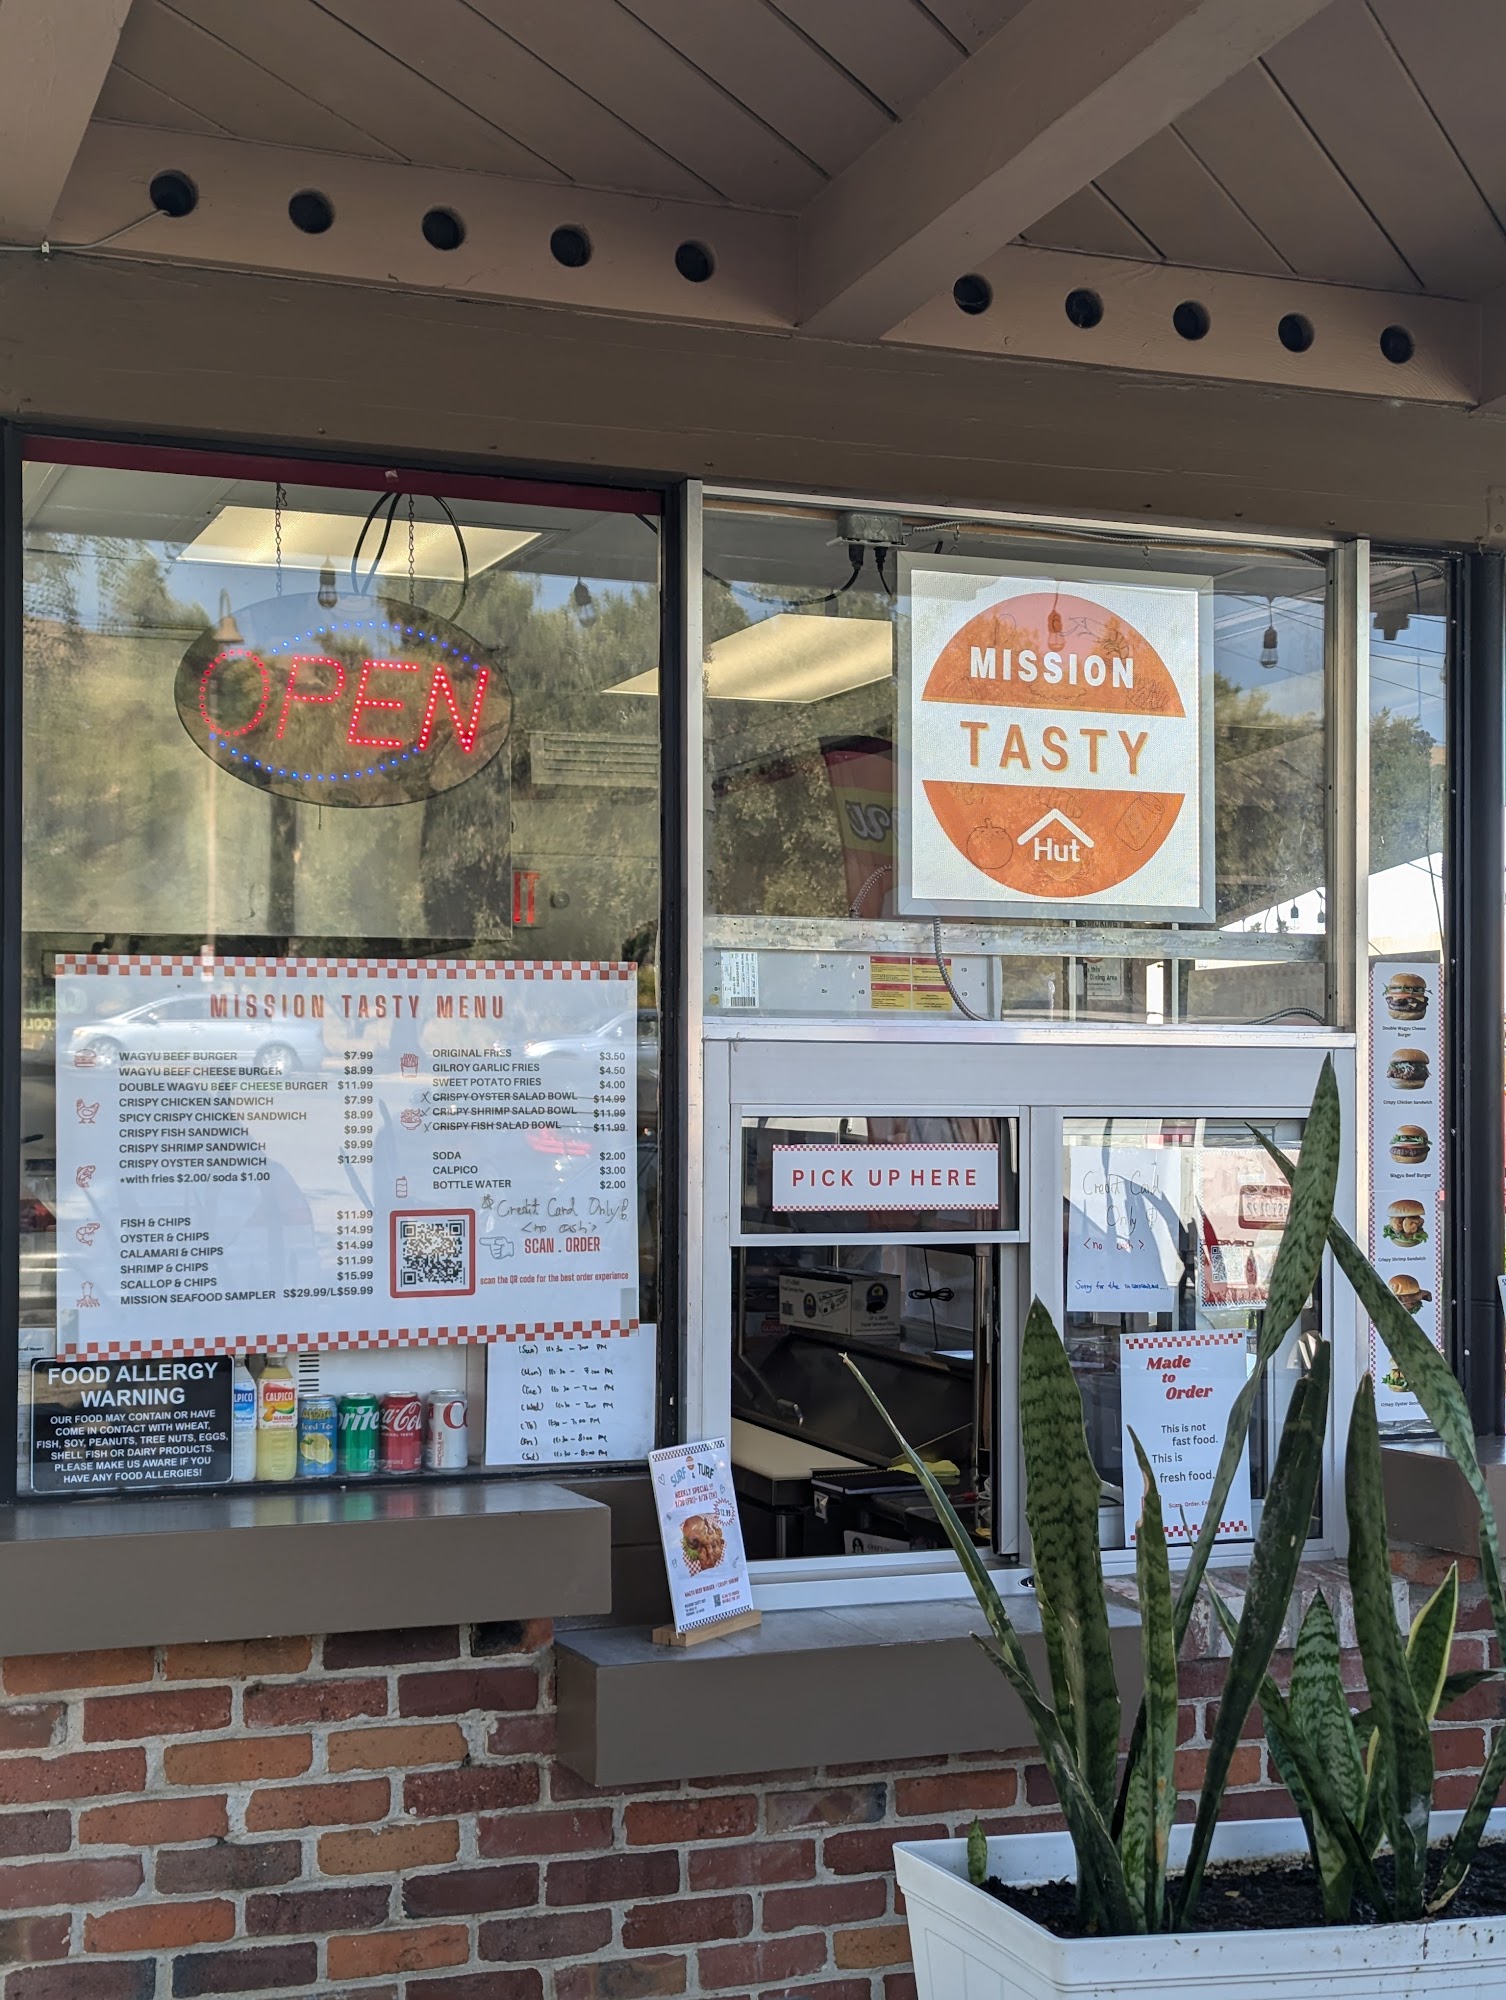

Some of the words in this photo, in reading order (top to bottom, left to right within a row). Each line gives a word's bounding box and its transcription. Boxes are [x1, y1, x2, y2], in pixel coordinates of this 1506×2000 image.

[970, 646, 1134, 689] MISSION
[199, 648, 491, 752] OPEN
[959, 720, 1149, 776] TASTY
[1034, 837, 1081, 863] Hut
[210, 993, 325, 1018] MISSION
[341, 994, 420, 1018] TASTY
[437, 995, 504, 1019] MENU
[119, 1052, 161, 1062] WAGYU
[163, 1052, 191, 1061] BEEF
[193, 1052, 238, 1061] BURGER
[344, 1051, 373, 1061] $7.99
[432, 1049, 480, 1058] ORIGINAL
[482, 1049, 512, 1058] FRIES
[599, 1052, 625, 1061] $3.50
[432, 1063, 470, 1073] GILROY
[472, 1063, 511, 1072] GARLIC
[513, 1063, 540, 1072] FRIES
[599, 1066, 625, 1075] $4.50
[119, 1082, 165, 1092] DOUBLE
[167, 1082, 208, 1091] WAGYU
[210, 1082, 239, 1091] BEEF
[241, 1082, 283, 1091] CHEESE
[285, 1081, 328, 1090] BURGER
[337, 1080, 373, 1090] $11.99
[432, 1078, 469, 1087] SWEET
[471, 1078, 512, 1087] POTATO
[513, 1077, 542, 1087] FRIES
[599, 1080, 625, 1090] $4.00
[119, 1097, 159, 1107] CRISPY
[161, 1097, 211, 1107] CHICKEN
[213, 1096, 274, 1106] SANDWICH
[344, 1095, 373, 1105] $7.99
[119, 1158, 159, 1169] CRISPY
[161, 1158, 204, 1168] OYSTER
[206, 1157, 267, 1167] SANDWICH
[337, 1154, 373, 1164] $12.99
[151, 1173, 175, 1184] fries
[213, 1172, 238, 1182] soda
[240, 1171, 270, 1182] $1.00
[432, 1166, 478, 1175] CALPICO
[599, 1166, 625, 1175] $3.00
[792, 1169, 854, 1187] PICK
[868, 1169, 901, 1186] UP
[910, 1169, 977, 1186] HERE
[432, 1180, 473, 1190] BOTTLE
[475, 1179, 512, 1189] WATER
[599, 1180, 625, 1190] $2.00
[496, 1199, 540, 1218] Credit
[547, 1198, 578, 1218] Card
[120, 1218, 145, 1228] FISH
[157, 1217, 191, 1227] CHIPS
[336, 1209, 373, 1220] $11.99
[1106, 1205, 1137, 1236] Only
[120, 1233, 164, 1243] OYSTER
[176, 1232, 209, 1242] CHIPS
[336, 1225, 373, 1235] $14.99
[120, 1248, 179, 1259] CALAMARI
[190, 1247, 224, 1257] CHIPS
[336, 1240, 373, 1250] $14.99
[524, 1239, 555, 1254] SCAN
[566, 1237, 600, 1252] ORDER
[480, 1276, 494, 1285] scan
[495, 1276, 508, 1284] the
[519, 1274, 535, 1283] code
[537, 1274, 547, 1282] for
[548, 1274, 559, 1282] the
[560, 1273, 574, 1281] best
[576, 1273, 593, 1281] order
[595, 1272, 629, 1281] experience
[120, 1295, 168, 1306] MISSION
[170, 1292, 223, 1304] SEAFOOD
[224, 1290, 276, 1301] SAMPLER
[1146, 1354, 1192, 1371] Made
[48, 1366, 111, 1385] FOOD
[115, 1361, 219, 1383] ALLERGY
[1162, 1372, 1176, 1383] to
[81, 1387, 186, 1408] WARNING
[265, 1391, 294, 1402] CALPICO
[1166, 1385, 1214, 1400] Order
[50, 1415, 72, 1425] OUR
[74, 1414, 103, 1423] FOOD
[105, 1413, 126, 1422] MAY
[128, 1412, 172, 1421] CONTAIN
[173, 1410, 188, 1419] OR
[190, 1409, 216, 1418] HAVE
[55, 1427, 85, 1436] COME
[87, 1426, 97, 1435] IN
[99, 1424, 145, 1434] CONTACT
[148, 1423, 173, 1432] WITH
[1161, 1425, 1180, 1434] This
[1181, 1424, 1189, 1432] is
[1191, 1423, 1206, 1432] not
[36, 1440, 62, 1449] FISH,
[64, 1438, 87, 1448] SOY,
[140, 1435, 166, 1445] TREE
[199, 1432, 229, 1442] EGGS,
[1172, 1435, 1191, 1446] fast
[1193, 1434, 1219, 1445] food.
[51, 1451, 83, 1461] SHELL
[85, 1450, 108, 1459] FISH
[110, 1449, 125, 1457] OR
[127, 1447, 157, 1457] DAIRY
[1152, 1454, 1173, 1464] This
[1175, 1453, 1183, 1462] is
[54, 1462, 94, 1472] PLEASE
[96, 1461, 124, 1470] MAKE
[127, 1460, 140, 1468] US
[143, 1458, 177, 1467] AWARE
[180, 1457, 188, 1466] IF
[190, 1456, 211, 1465] YOU
[63, 1474, 90, 1484] HAVE
[92, 1473, 112, 1482] ANY
[115, 1472, 143, 1481] FOOD
[145, 1468, 202, 1479] ALLERGIES!
[1159, 1472, 1186, 1483] fresh
